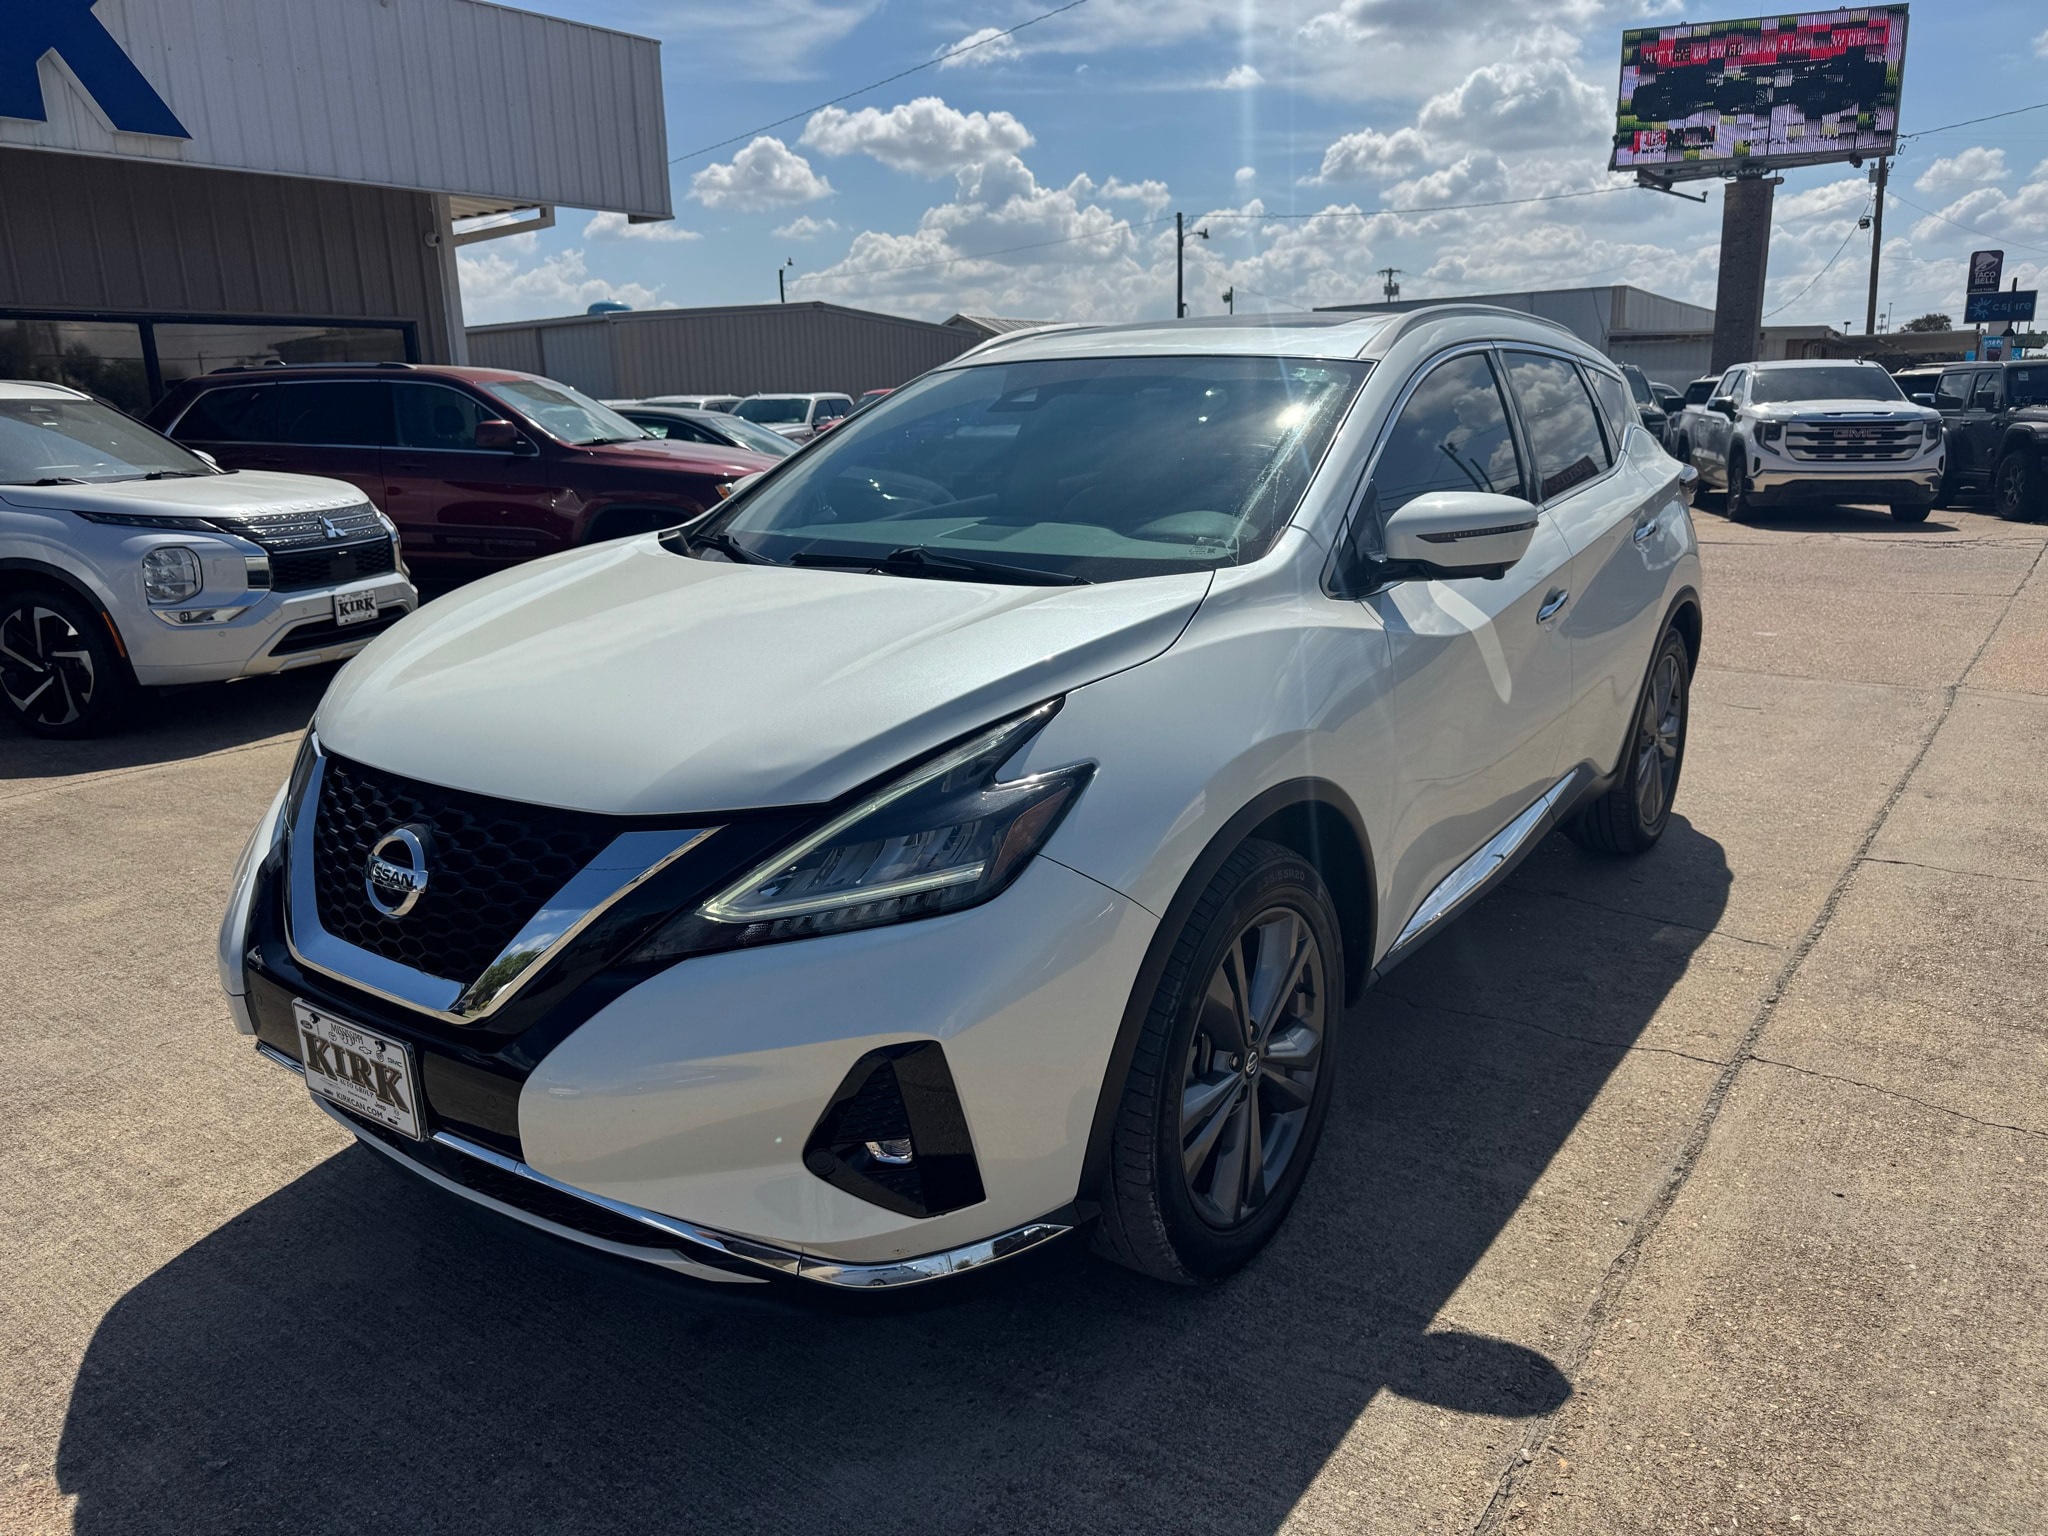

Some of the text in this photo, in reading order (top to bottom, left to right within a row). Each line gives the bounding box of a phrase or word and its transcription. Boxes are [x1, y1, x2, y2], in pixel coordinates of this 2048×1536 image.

[1722, 168, 1769, 177] LAMAR
[1833, 428, 1882, 438] GMC
[338, 597, 375, 616] KIRK
[365, 859, 415, 887] NISSAN
[301, 1029, 410, 1114] KIRK
[335, 1091, 384, 1119] KIRKCAN.COM
